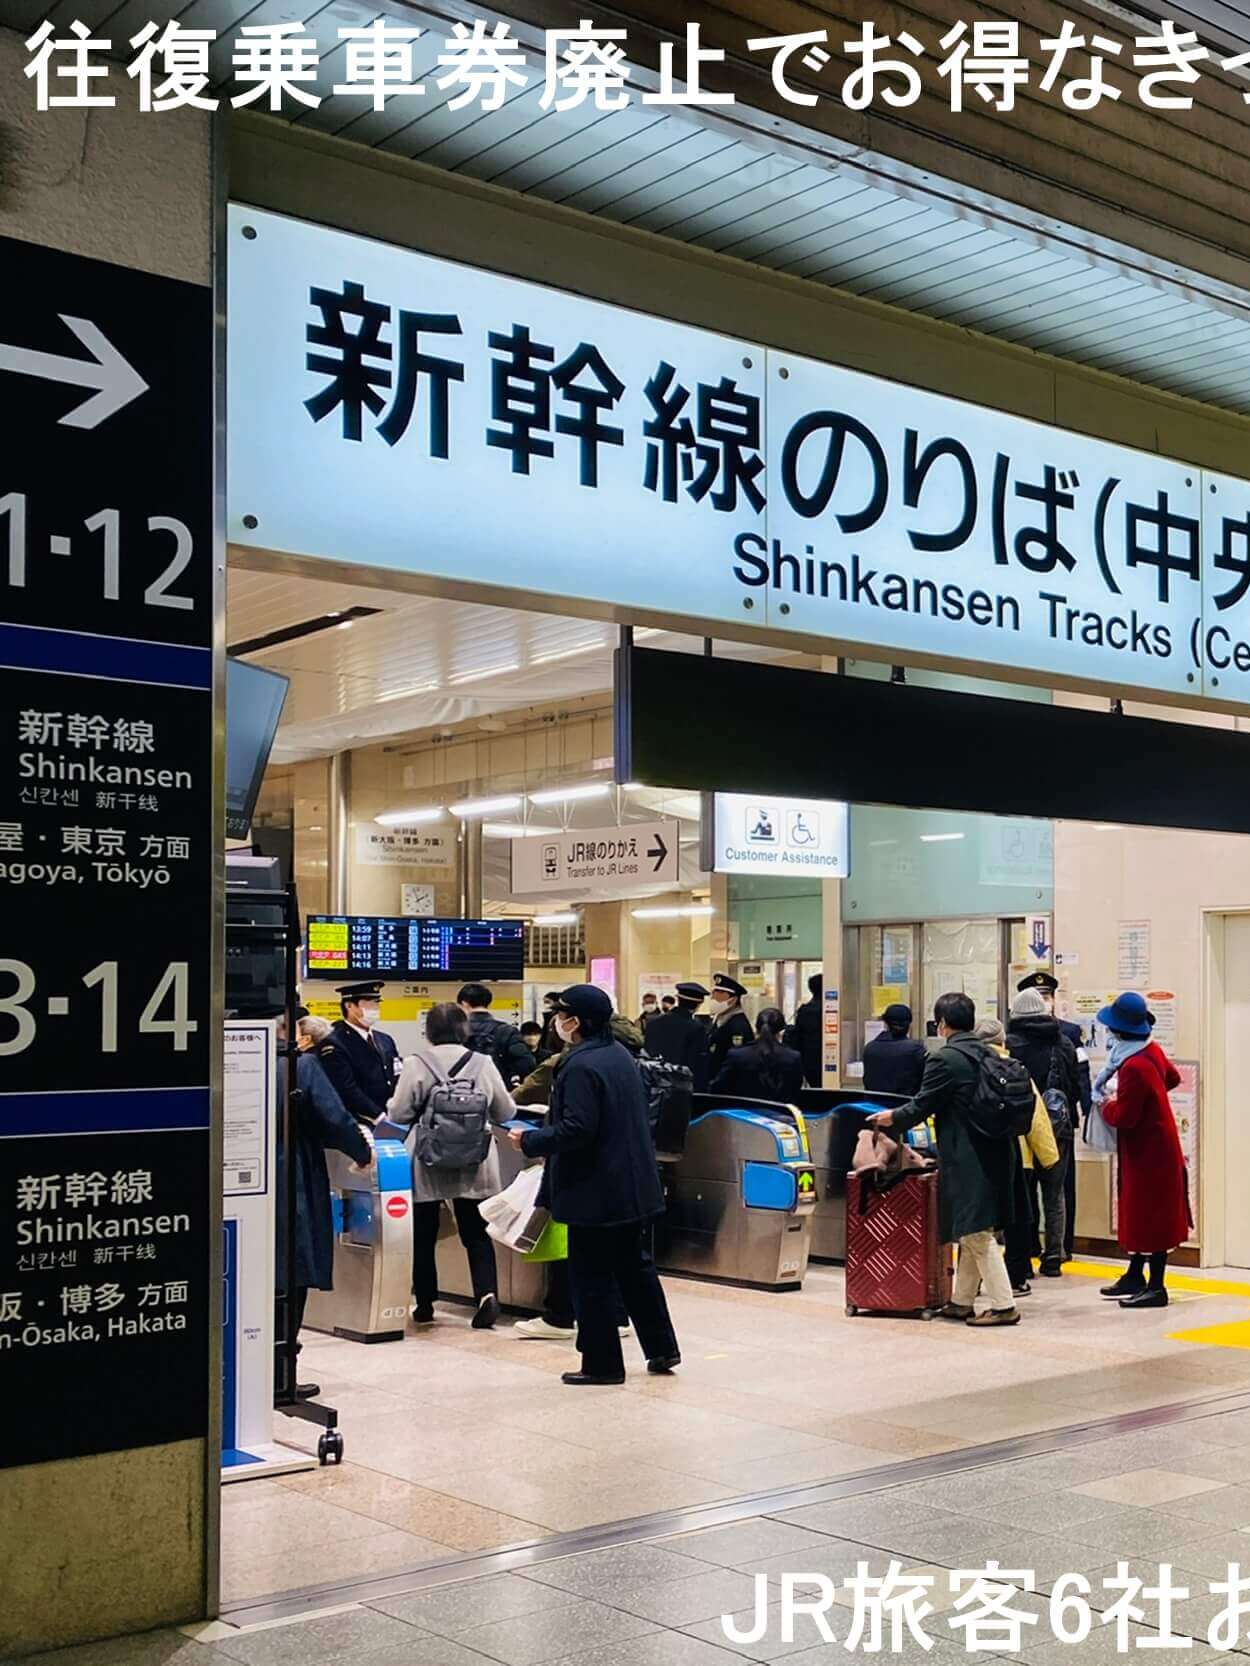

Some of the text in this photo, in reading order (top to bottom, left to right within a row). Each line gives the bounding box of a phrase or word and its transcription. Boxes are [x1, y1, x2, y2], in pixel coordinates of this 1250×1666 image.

[733, 531, 1020, 631] Shinkansen
[1039, 592, 1172, 658] Tracks
[18, 709, 155, 754] 新幹線
[18, 752, 192, 790] Shinkansen
[19, 786, 80, 807] 신칸센
[140, 835, 191, 859] 方面
[567, 838, 638, 864] JR線のりかえ
[725, 847, 838, 866] Customer Assistance
[91, 862, 170, 888] Tōkyō
[567, 863, 638, 879] Transfer to JR Lines
[16, 1168, 153, 1211] 新幹線
[16, 1213, 190, 1245] Shinkansen
[16, 1249, 78, 1271] 신칸센
[137, 1280, 189, 1307] 方面
[108, 1312, 187, 1337] Hakata
